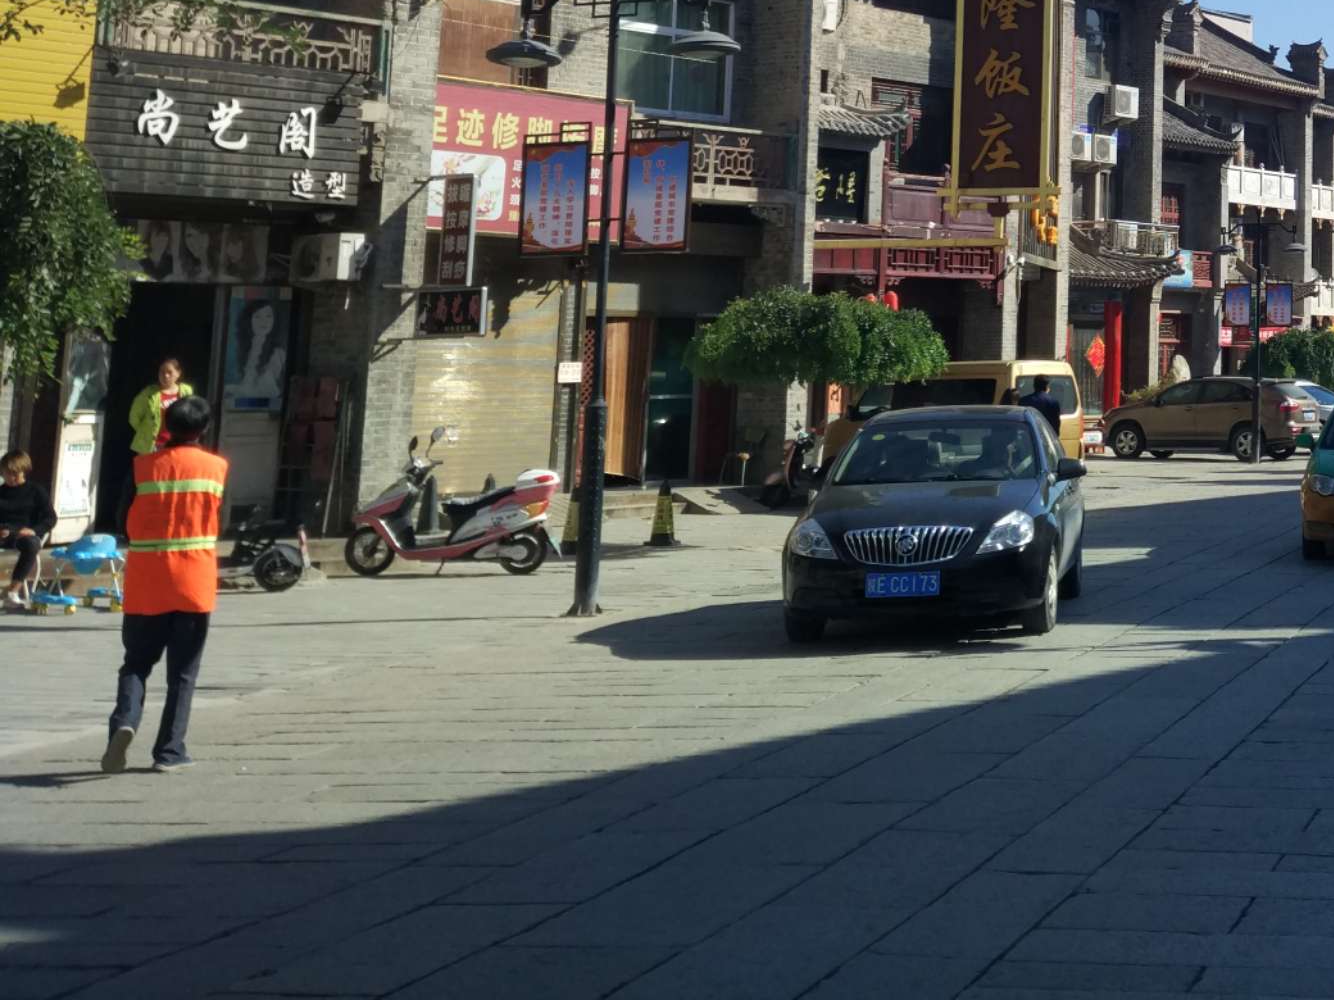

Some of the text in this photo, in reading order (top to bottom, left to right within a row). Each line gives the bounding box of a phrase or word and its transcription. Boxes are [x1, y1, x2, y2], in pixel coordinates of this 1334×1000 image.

[138, 88, 318, 159] 尚艺阁
[292, 169, 347, 200] 造型
